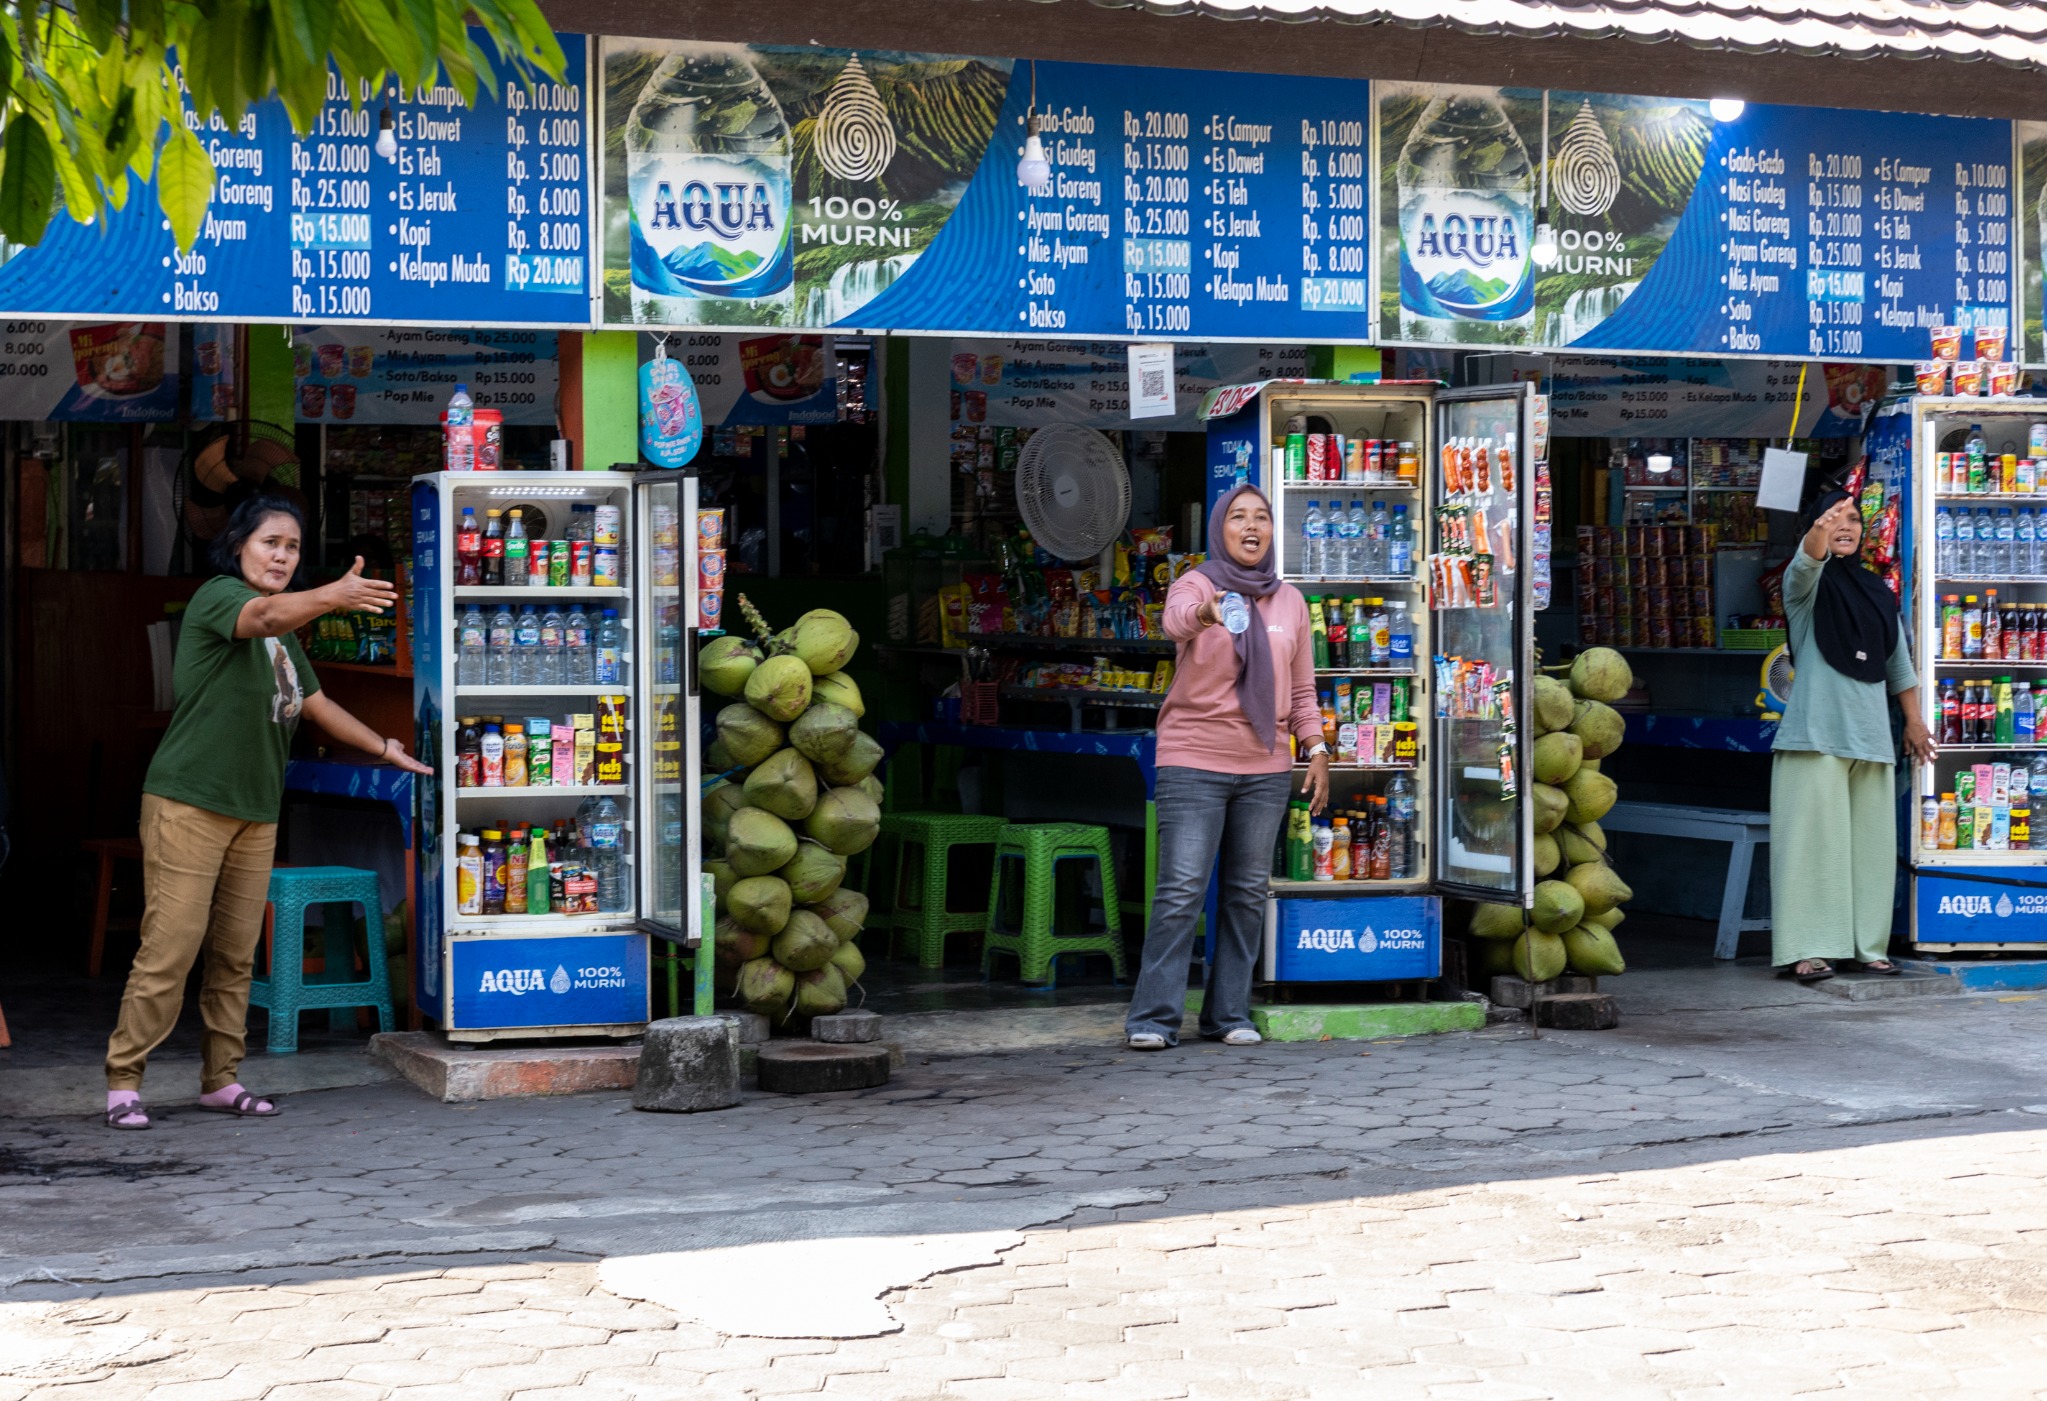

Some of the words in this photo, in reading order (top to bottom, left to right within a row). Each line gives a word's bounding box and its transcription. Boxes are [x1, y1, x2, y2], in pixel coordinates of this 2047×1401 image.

[320, 108, 369, 137] 15.000
[399, 112, 413, 140] Es
[418, 112, 461, 141] Dawet
[508, 116, 529, 151] Rp.
[540, 118, 580, 146] 6.000
[1027, 104, 1094, 134] ado-Gado
[1124, 110, 1144, 142] Rp.
[1145, 111, 1188, 138] 20.000
[1212, 115, 1224, 140] Es
[1228, 116, 1272, 148] Campur
[210, 138, 262, 176] Goreng
[292, 142, 314, 178] Rp.
[318, 143, 370, 173] 20.000
[399, 147, 414, 175] Es
[417, 145, 440, 176] Teh
[508, 151, 530, 186] Rp.
[540, 153, 580, 181] 5.000
[1057, 138, 1096, 174] Gudeg
[1124, 142, 1144, 175] Rp.
[1146, 144, 1188, 171] 15.000
[1212, 147, 1224, 172] Es
[1228, 148, 1264, 174] Dawet
[1302, 151, 1320, 182] Rp.
[1329, 152, 1362, 178] 6.000
[1728, 147, 1784, 174] Gado-Gado
[220, 175, 273, 212] Goreng
[292, 178, 314, 213] Rp.
[318, 179, 370, 208] 25.000
[400, 182, 414, 210] Es
[417, 181, 456, 212] Jeruk
[508, 186, 530, 221] Rp.
[540, 188, 580, 216] 6.000
[1057, 172, 1100, 206] Goreng
[1124, 175, 1144, 207] Rp.
[1146, 176, 1188, 203] 20.000
[1212, 180, 1225, 204] Es
[1227, 178, 1248, 205] Teh
[1302, 182, 1320, 214] Rp.
[1329, 184, 1362, 209] 5.000
[1729, 178, 1750, 202] Nasi
[1753, 178, 1786, 210] Gudeg
[651, 180, 774, 240] AQUA
[808, 196, 903, 222] 100%
[1027, 204, 1062, 236] Ayam
[1066, 205, 1110, 239] Goreng
[1125, 207, 1144, 239] Rp.
[1146, 208, 1189, 235] 25.000
[204, 210, 246, 247] Ayam
[292, 215, 314, 248] Rp
[319, 214, 370, 242] 15.000
[400, 217, 430, 250] Kopi
[508, 221, 530, 255] Rp.
[540, 222, 580, 250] 8.000
[801, 224, 912, 248] MURNI
[1213, 211, 1225, 236] Es
[1228, 210, 1260, 238] Jeruk
[1302, 214, 1321, 245] Rp.
[1329, 215, 1362, 240] 6.000
[1418, 213, 1518, 268] AQUA
[174, 247, 206, 276] Soto
[292, 250, 315, 284] Rp.
[319, 250, 370, 280] 15.000
[1028, 236, 1050, 262] Mie
[1054, 237, 1088, 270] Ayam
[1126, 240, 1144, 272] Rp
[1148, 241, 1190, 268] 15.000
[1214, 243, 1239, 274] Kopi
[1303, 246, 1321, 277] Rp.
[1330, 246, 1363, 272] 8.000
[1728, 237, 1758, 267] Ayam
[1760, 238, 1796, 270] Goreng
[400, 250, 448, 288] Kelapa
[452, 252, 490, 283] Muda
[508, 256, 530, 290] Rp
[533, 256, 580, 284] 20.000
[174, 280, 219, 311] Bakso
[292, 285, 316, 318] Rp.
[319, 286, 370, 315] 15.000
[1028, 268, 1056, 295] Soto
[1126, 272, 1144, 304] Rp.
[1147, 273, 1190, 299] 15.000
[1214, 274, 1252, 306] Kelapa
[1256, 274, 1288, 301] Muda
[1304, 280, 1320, 309] Rp
[1324, 280, 1363, 306] 20.000
[6, 322, 46, 334] 6.000
[1029, 300, 1066, 328] Bakso
[1126, 304, 1144, 336] Rp.
[1147, 304, 1190, 331] 15.000
[1882, 303, 1914, 332] Kelapa
[1917, 304, 1944, 328] Muda
[5, 342, 45, 355] 8.000
[387, 330, 422, 344] Ayam
[425, 331, 470, 345] Goreng
[475, 332, 492, 344] Rp
[494, 332, 536, 344] 25.000
[689, 336, 720, 346] 6.000
[1730, 324, 1760, 350] Bakso
[386, 370, 457, 382] Soto/Bakso
[476, 372, 491, 384] Rp
[494, 372, 536, 384] 15.000
[1014, 378, 1075, 390] Soto/Bakso
[1259, 367, 1272, 378] Rp
[1277, 367, 1304, 378] 8.000
[384, 390, 409, 403] Pop
[412, 391, 434, 402] Mie
[476, 392, 491, 405] Rp
[494, 393, 536, 404] 15.000
[1012, 396, 1034, 409] Pop
[1036, 398, 1056, 408] Mie
[1621, 392, 1634, 402] Rp
[1635, 392, 1668, 402] 15.000
[122, 406, 175, 420] Indofood
[788, 410, 836, 422] Indofood
[1620, 410, 1634, 420] Rp
[1635, 410, 1667, 419] 15.000
[598, 758, 622, 773] teh
[1938, 896, 1992, 918] AQUA
[1297, 928, 1356, 953] AQUA
[1380, 940, 1424, 950] MURNI
[1383, 930, 1422, 939] 100%
[479, 970, 546, 996] AQUA
[574, 978, 626, 990] MURNI
[578, 966, 622, 978] 100%
